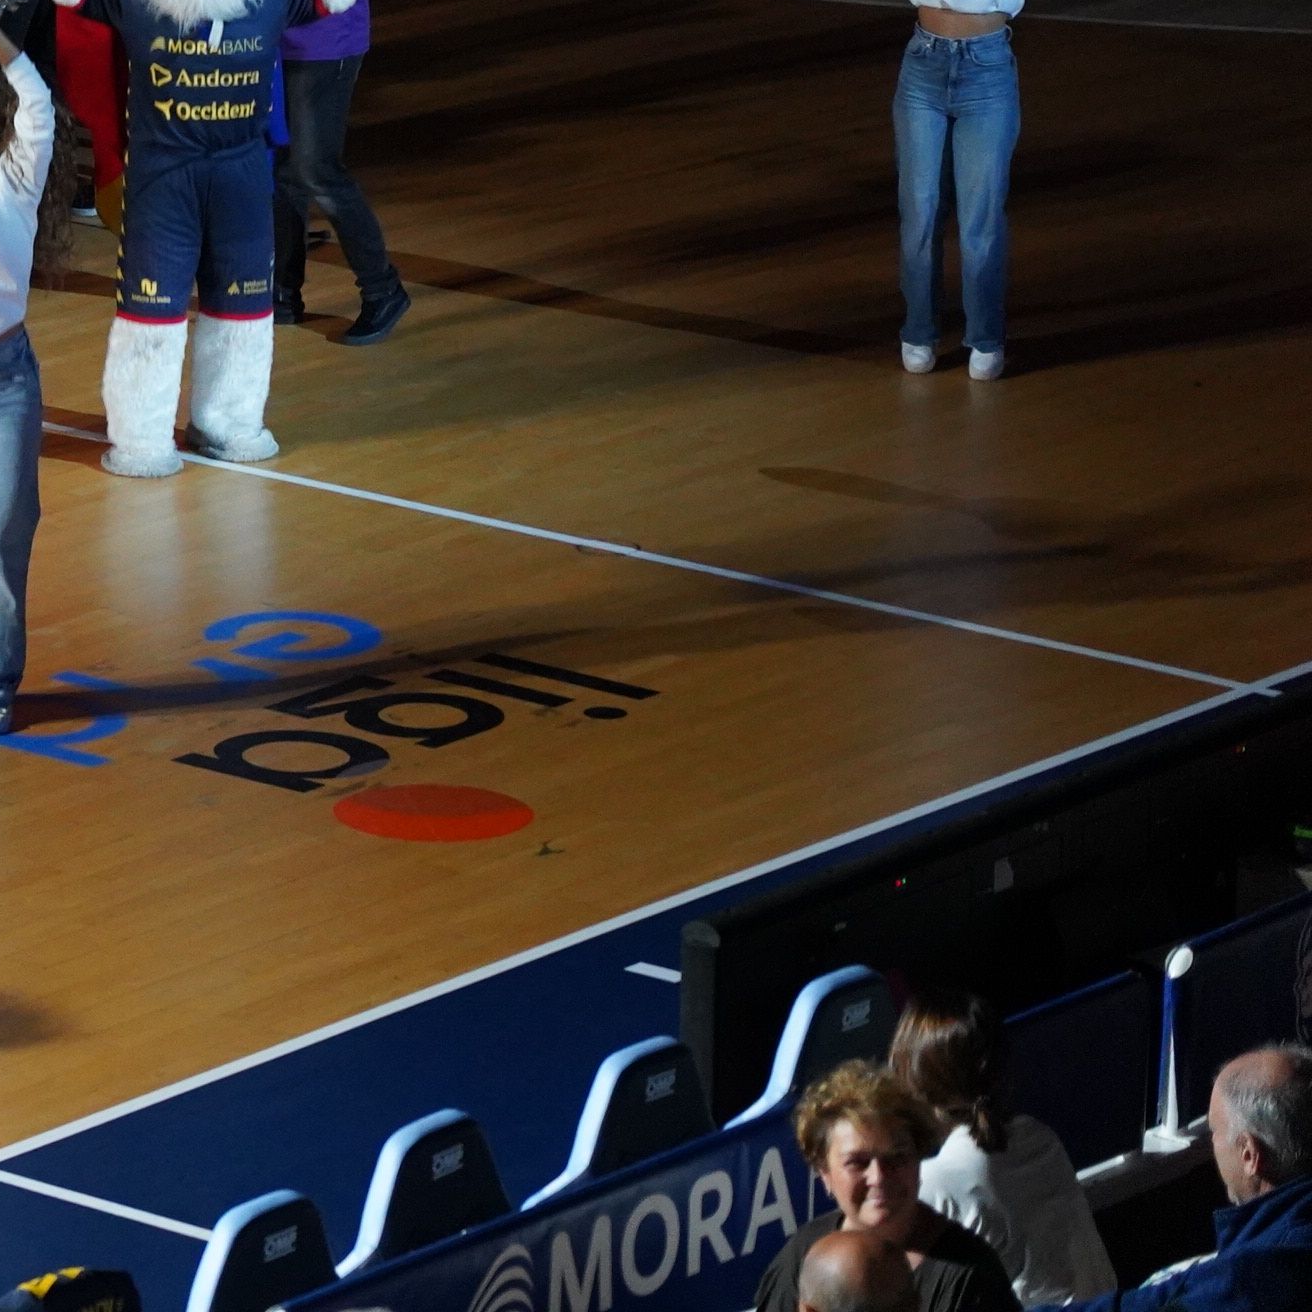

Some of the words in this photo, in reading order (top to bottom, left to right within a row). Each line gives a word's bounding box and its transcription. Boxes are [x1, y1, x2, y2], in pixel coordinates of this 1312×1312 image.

[175, 68, 260, 87] Andorra
[176, 99, 256, 121] Occident
[175, 651, 661, 793] liga
[548, 1145, 820, 1312] MORA
